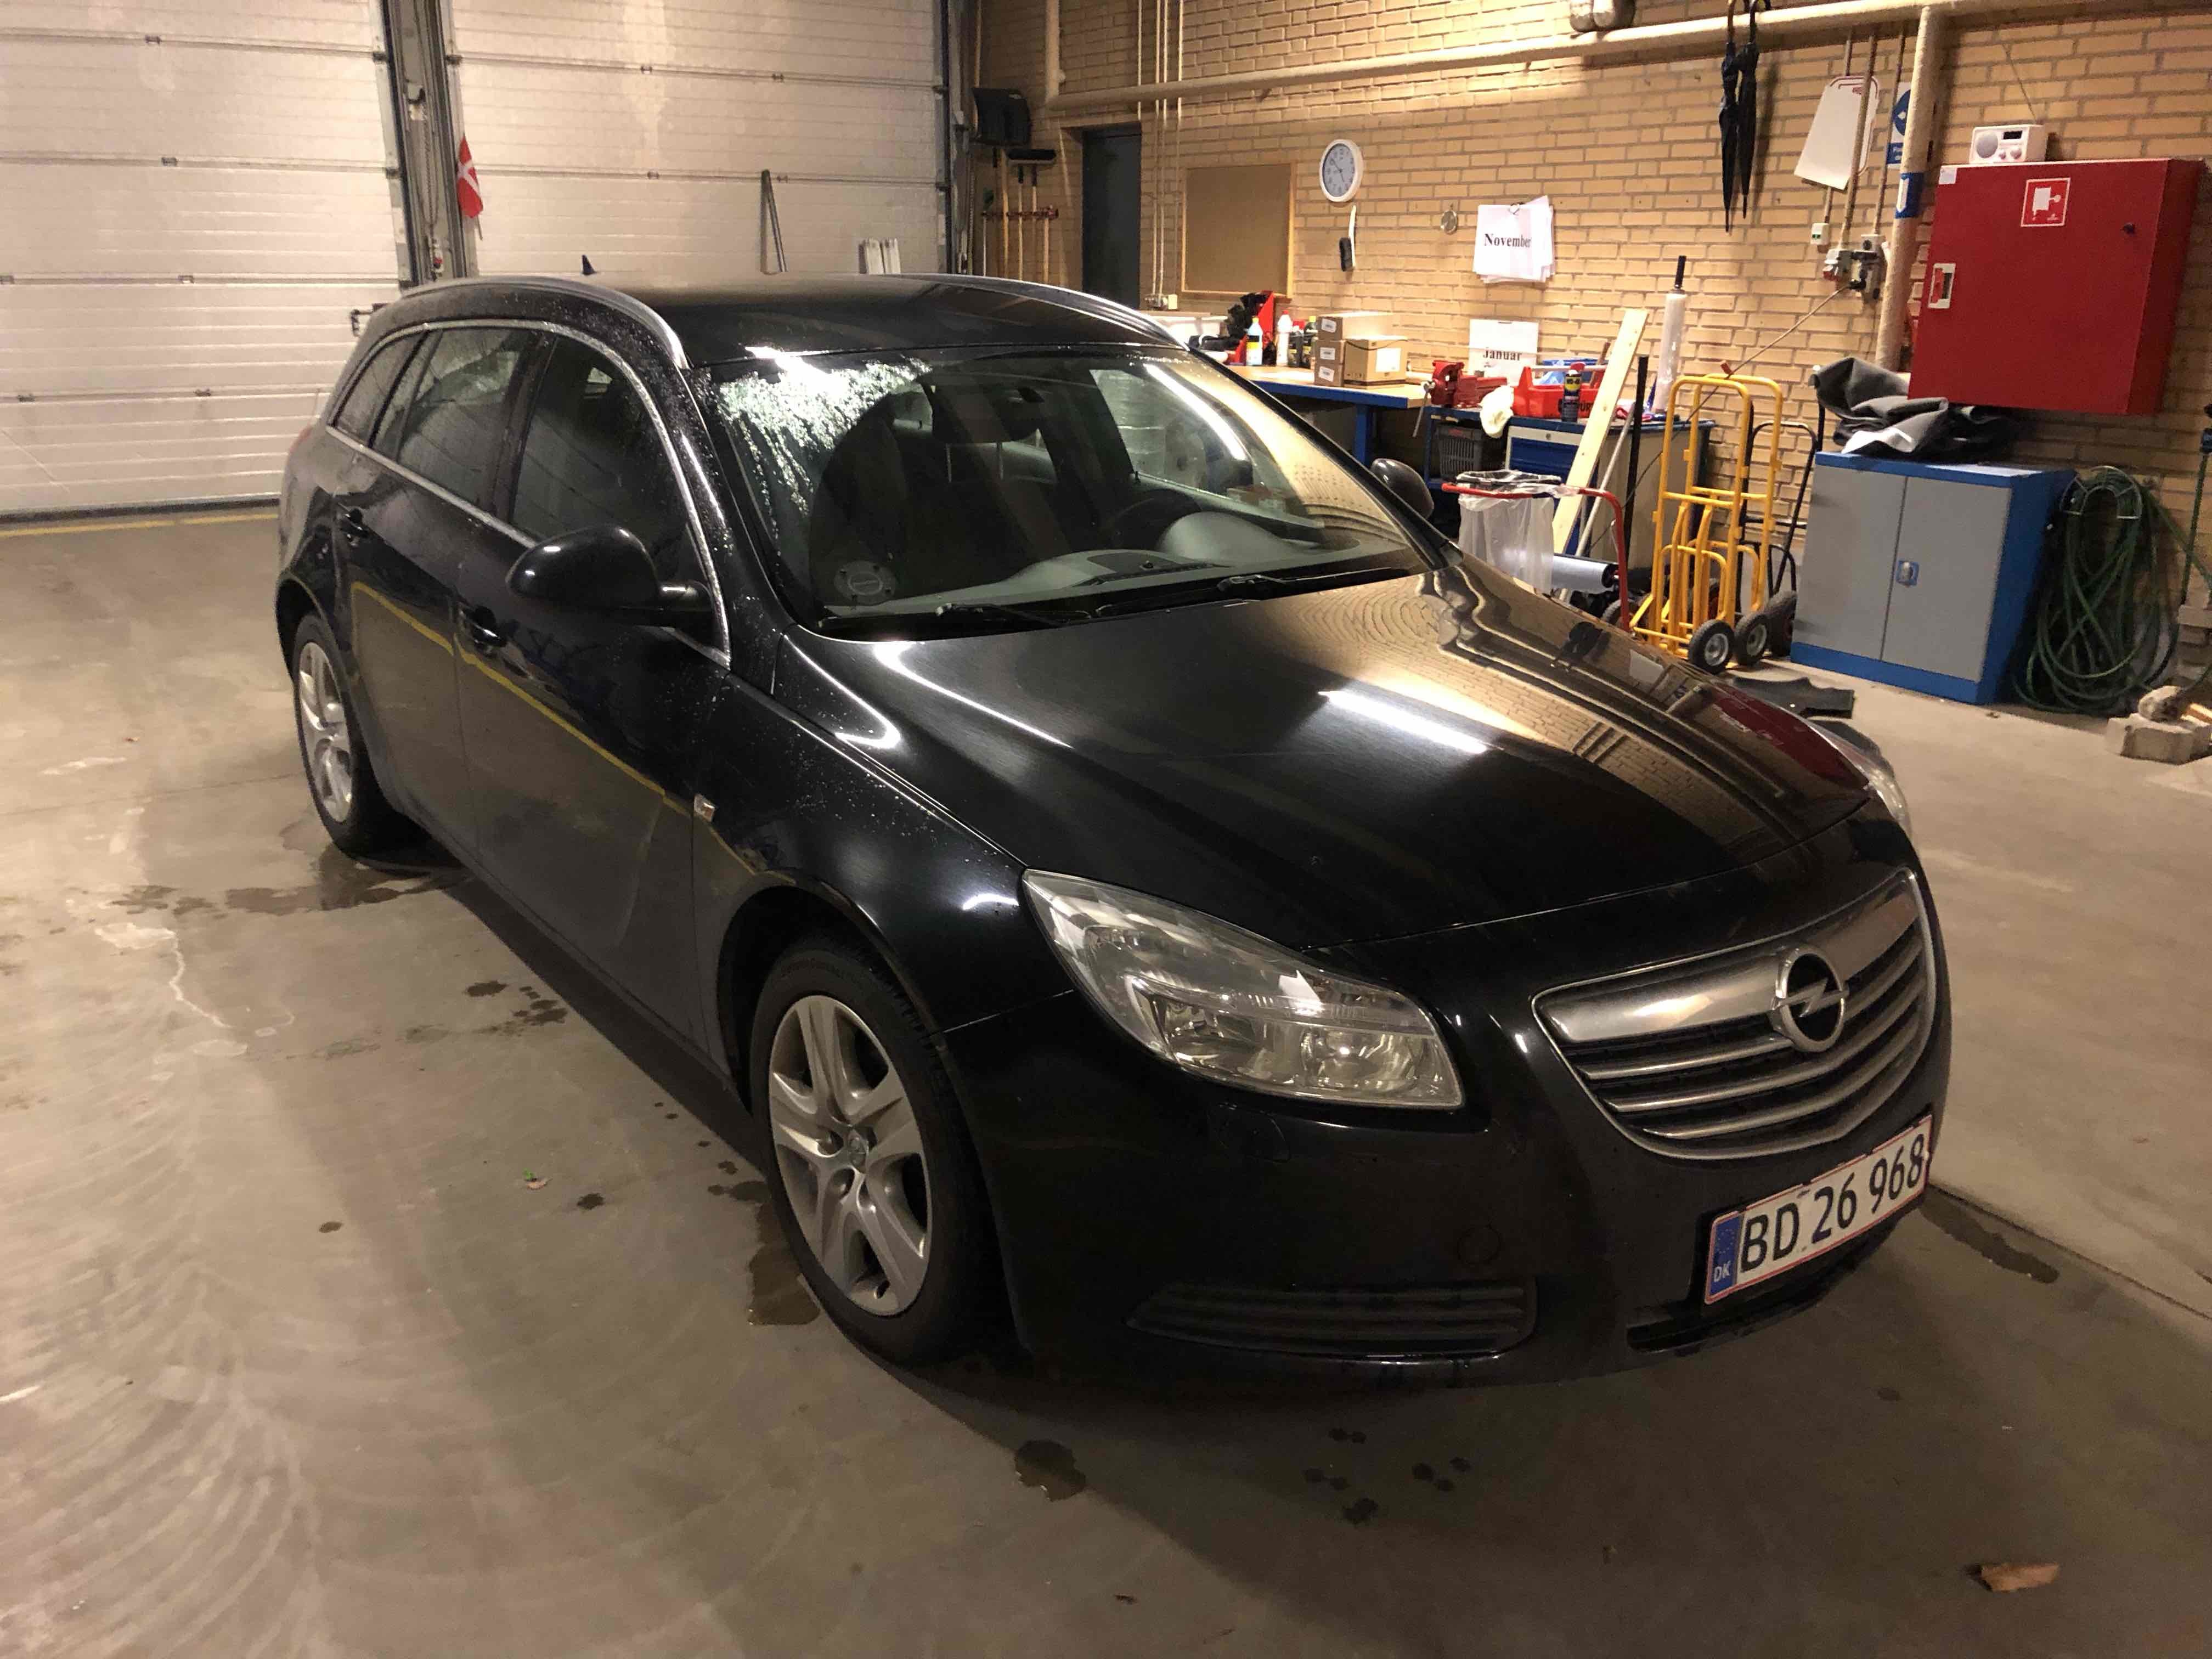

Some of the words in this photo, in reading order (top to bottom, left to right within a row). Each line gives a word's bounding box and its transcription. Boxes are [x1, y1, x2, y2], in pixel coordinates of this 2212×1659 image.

[1484, 233, 1531, 248] November
[1483, 346, 1522, 360] Januar
[1740, 1202, 1800, 1273] BD
[1812, 1172, 1857, 1244] 26
[1869, 1133, 1925, 1215] 968
[1713, 1261, 1730, 1283] DK
